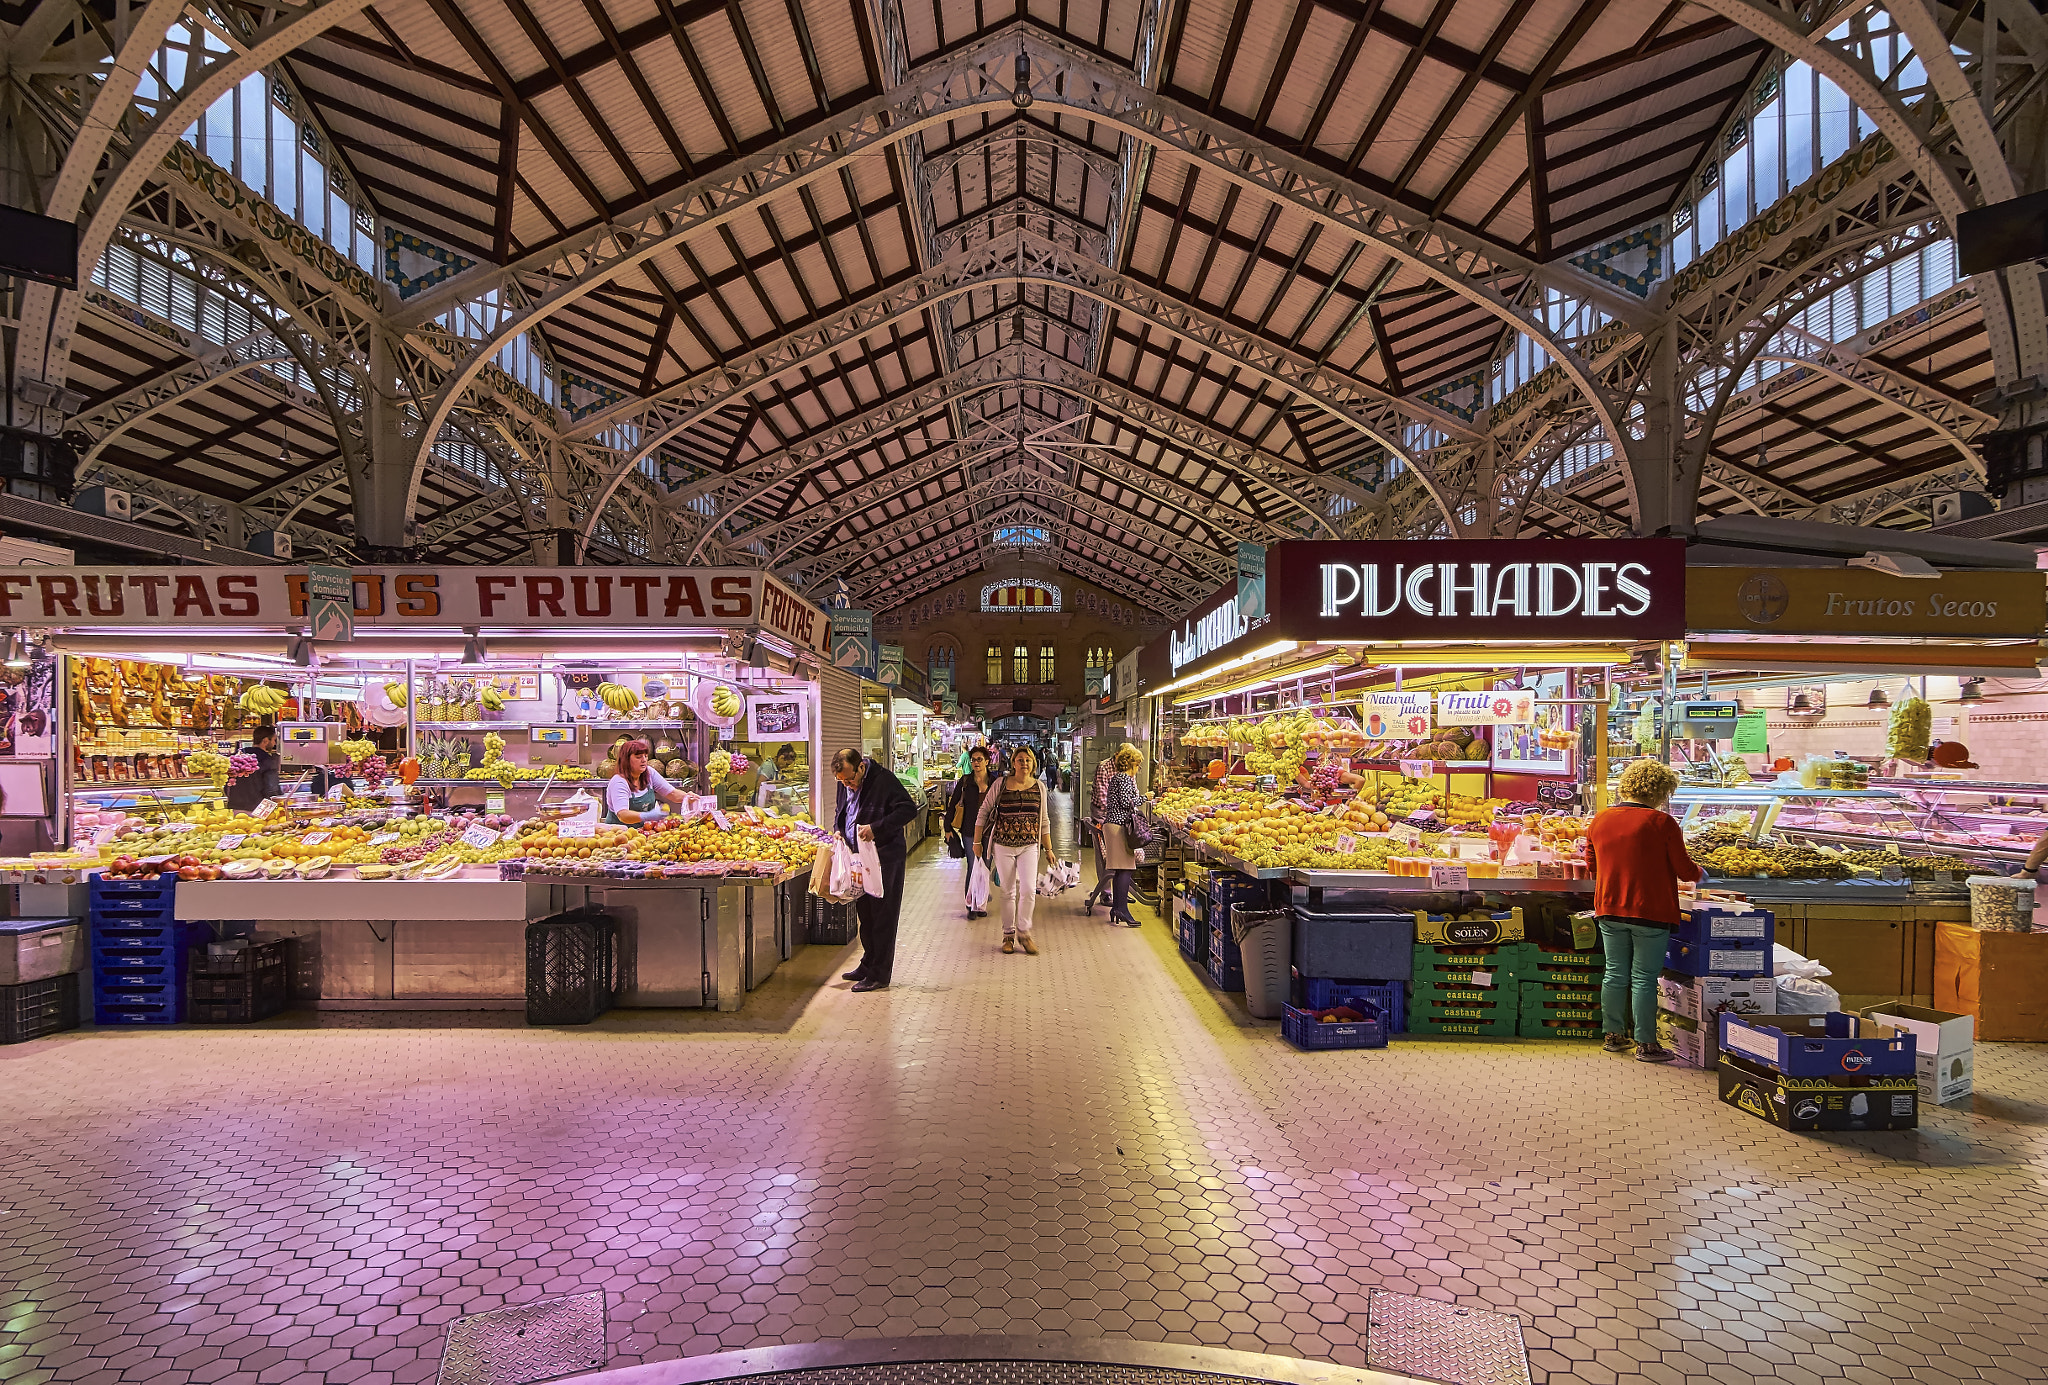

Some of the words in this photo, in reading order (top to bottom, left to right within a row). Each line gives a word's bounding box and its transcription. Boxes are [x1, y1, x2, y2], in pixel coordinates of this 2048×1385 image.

[311, 571, 344, 584] Servicio
[313, 583, 350, 596] domicilio
[1319, 562, 1652, 618] PUCHADES
[0, 575, 260, 617] FRUTAS
[476, 576, 753, 617] FRUTAS
[760, 579, 815, 644] FRUTAS
[1824, 592, 1915, 617] Frutos
[1927, 593, 1998, 618] Secos
[834, 614, 863, 623] Servicio
[834, 624, 869, 632] domicilio
[1366, 694, 1415, 705] Natural
[1442, 693, 1491, 710] Fruit
[1398, 704, 1429, 717] juice
[1454, 929, 1488, 938] SOLEN
[1447, 955, 1484, 965] castang
[1552, 954, 1590, 964] castang
[1447, 973, 1472, 981] casta
[1551, 973, 1589, 983] castang
[1446, 991, 1483, 1001] castang
[1556, 992, 1592, 1001] castang
[1444, 1009, 1481, 1019] castang
[1556, 1010, 1592, 1020] castang
[1442, 1025, 1479, 1035] castang
[1556, 1028, 1593, 1038] castang
